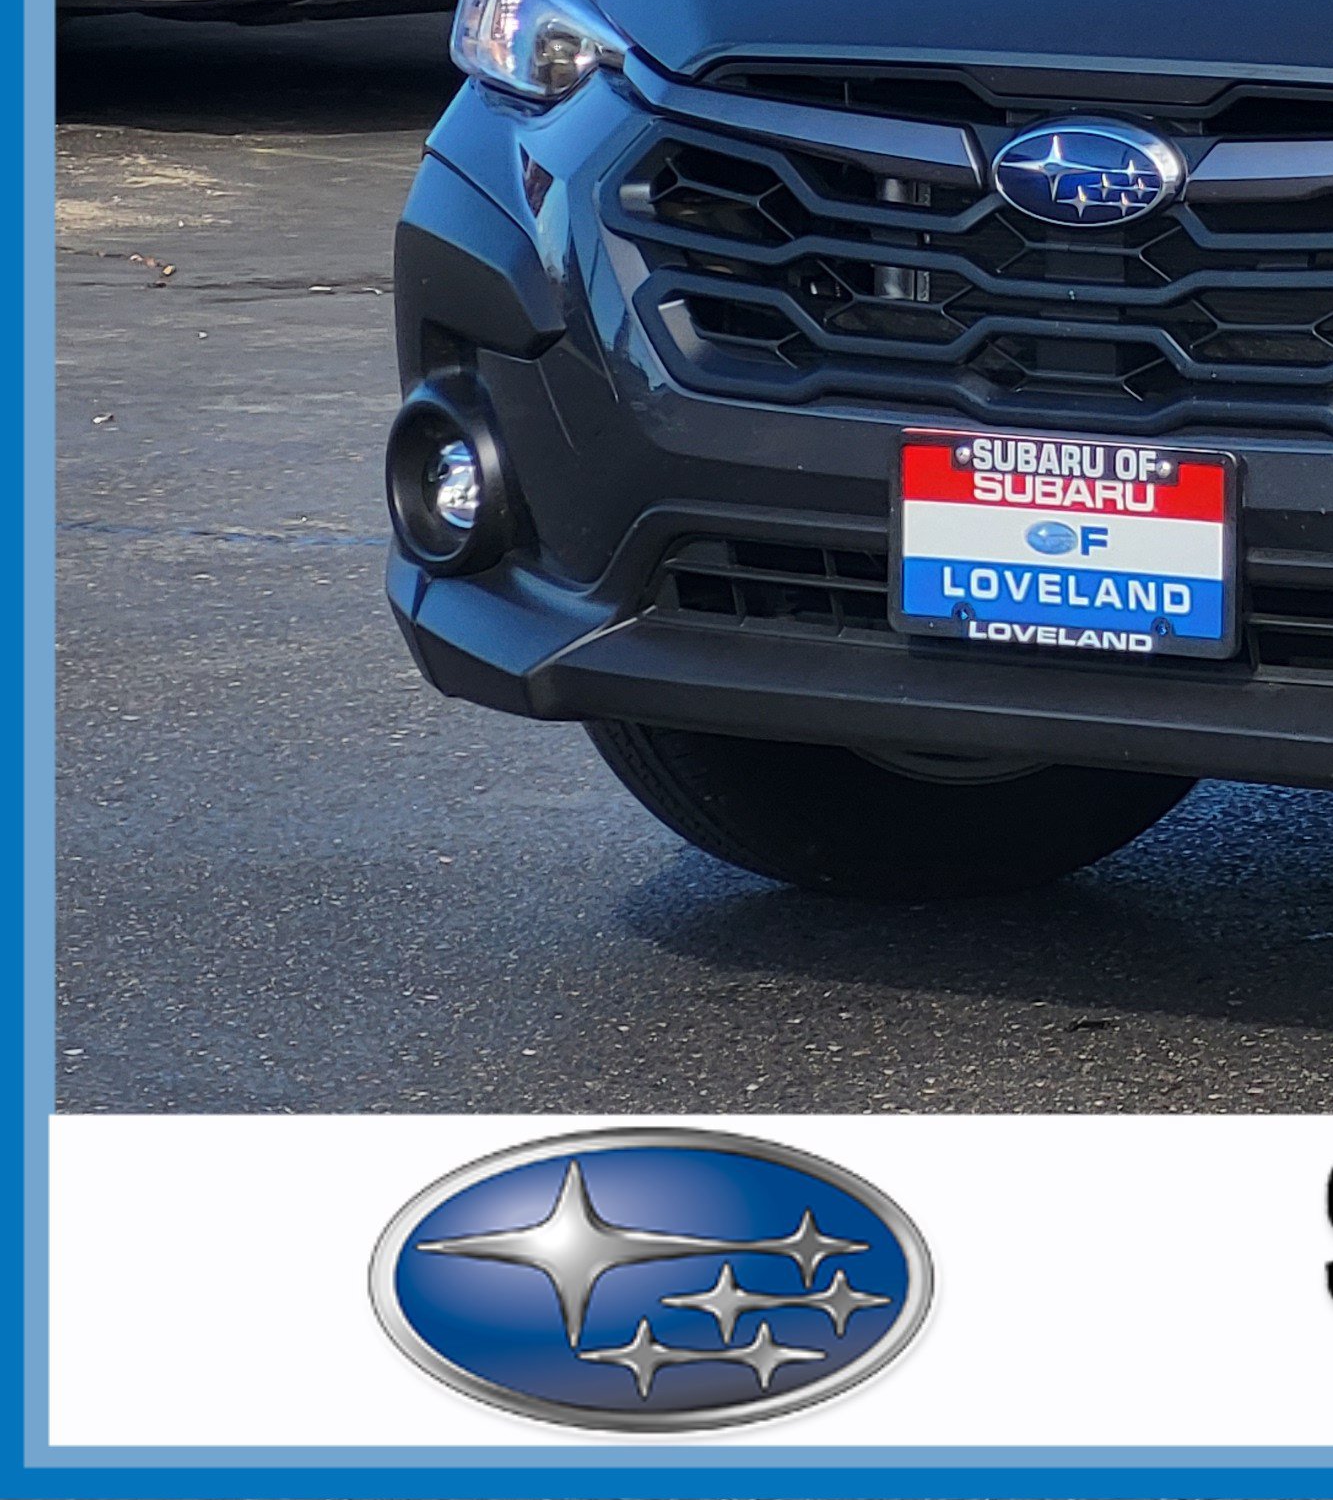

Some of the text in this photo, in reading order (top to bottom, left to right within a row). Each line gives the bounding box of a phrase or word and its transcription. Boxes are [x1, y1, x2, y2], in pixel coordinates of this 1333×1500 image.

[972, 438, 1157, 481] SUBARU OF
[973, 472, 1155, 512] SUBARU
[942, 566, 1192, 615] LOVELAND
[968, 620, 1153, 652] LOVELAND
